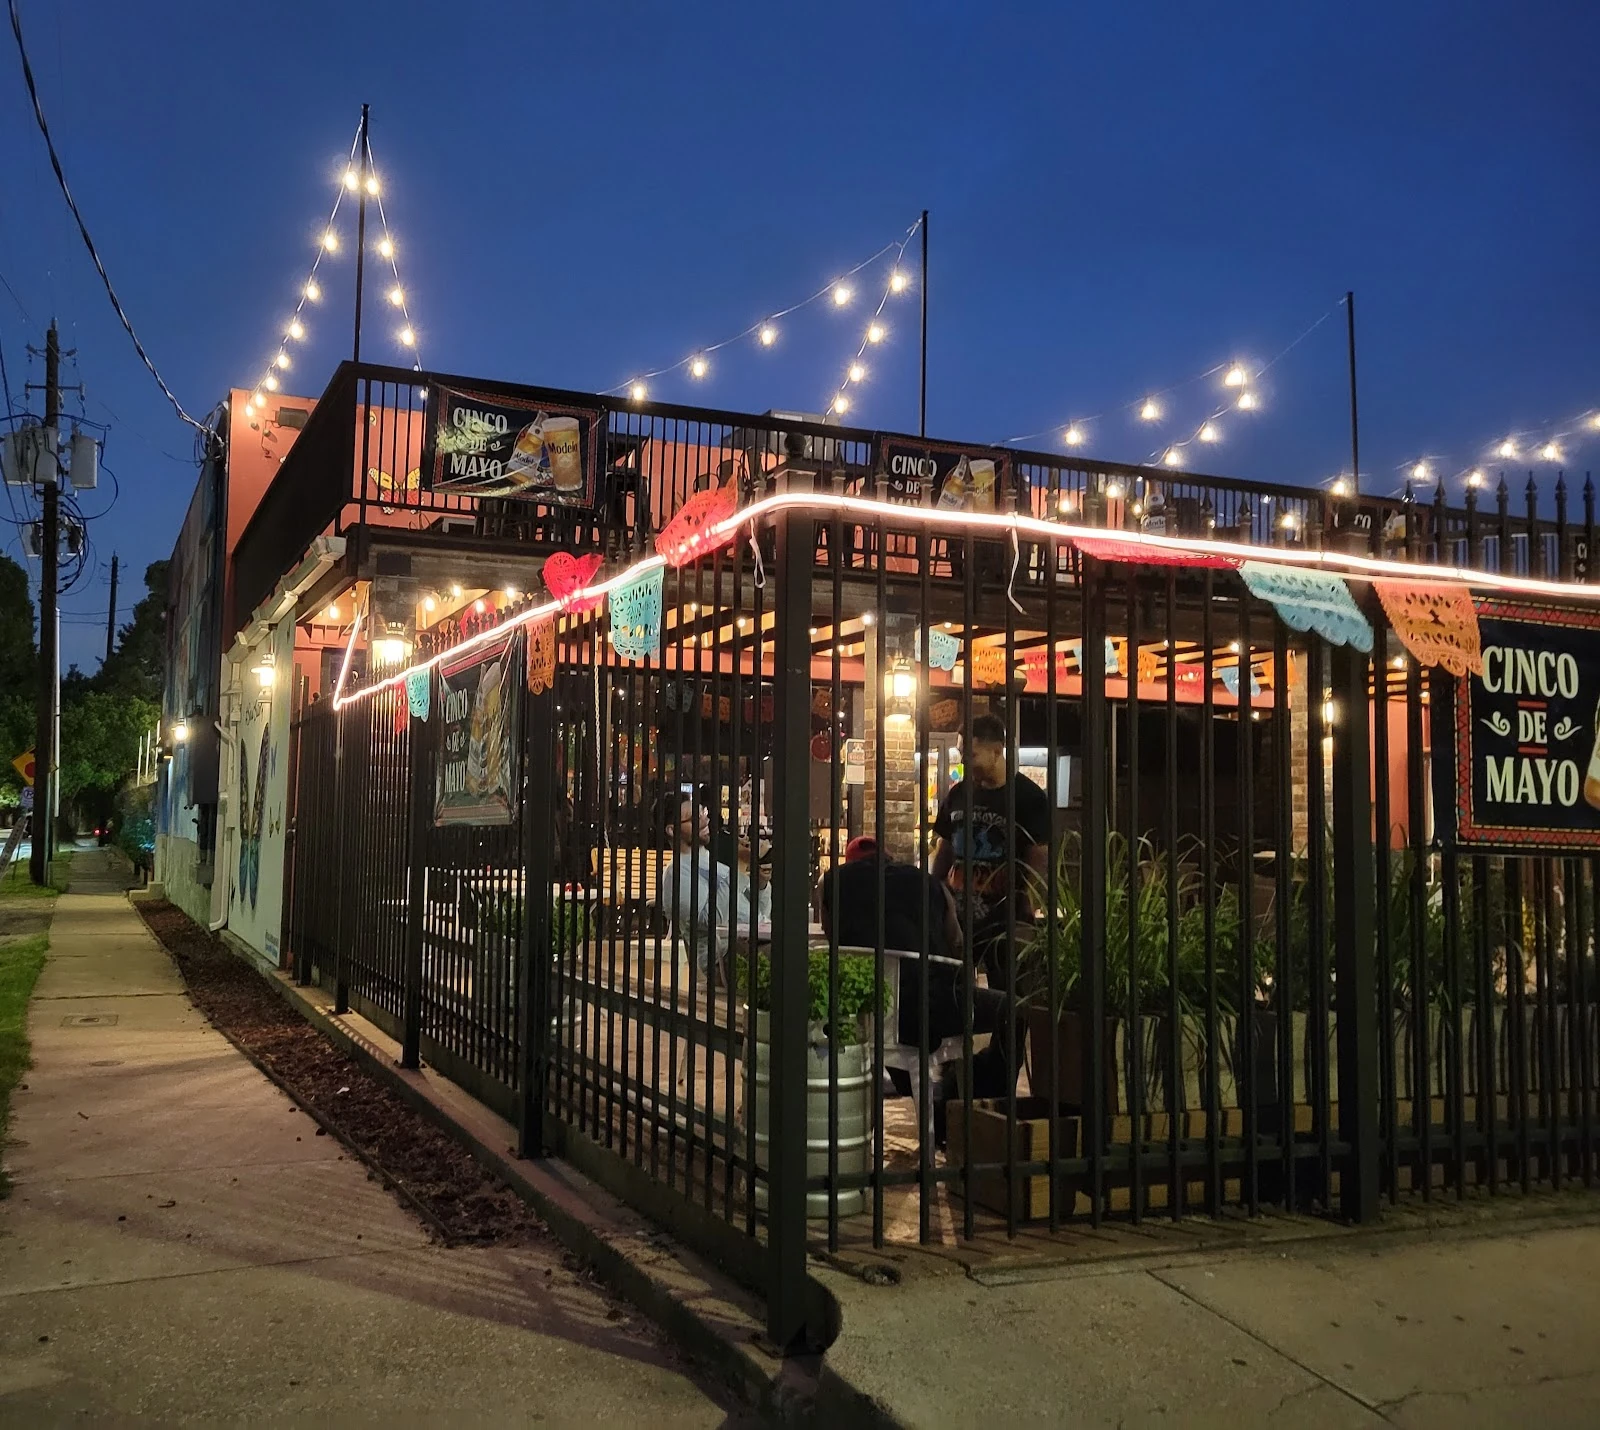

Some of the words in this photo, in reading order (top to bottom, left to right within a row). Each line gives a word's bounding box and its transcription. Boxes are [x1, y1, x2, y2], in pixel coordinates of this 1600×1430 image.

[453, 407, 508, 434] CINCO
[469, 436, 487, 452] DE
[450, 452, 502, 479] MAYO
[891, 455, 938, 478] CINCO
[906, 480, 921, 495] DE
[1482, 645, 1580, 699] CINCO
[445, 688, 468, 724] CINCO
[1517, 710, 1548, 744] DE
[444, 760, 466, 793] MAYO
[1485, 755, 1580, 807] MAYO
